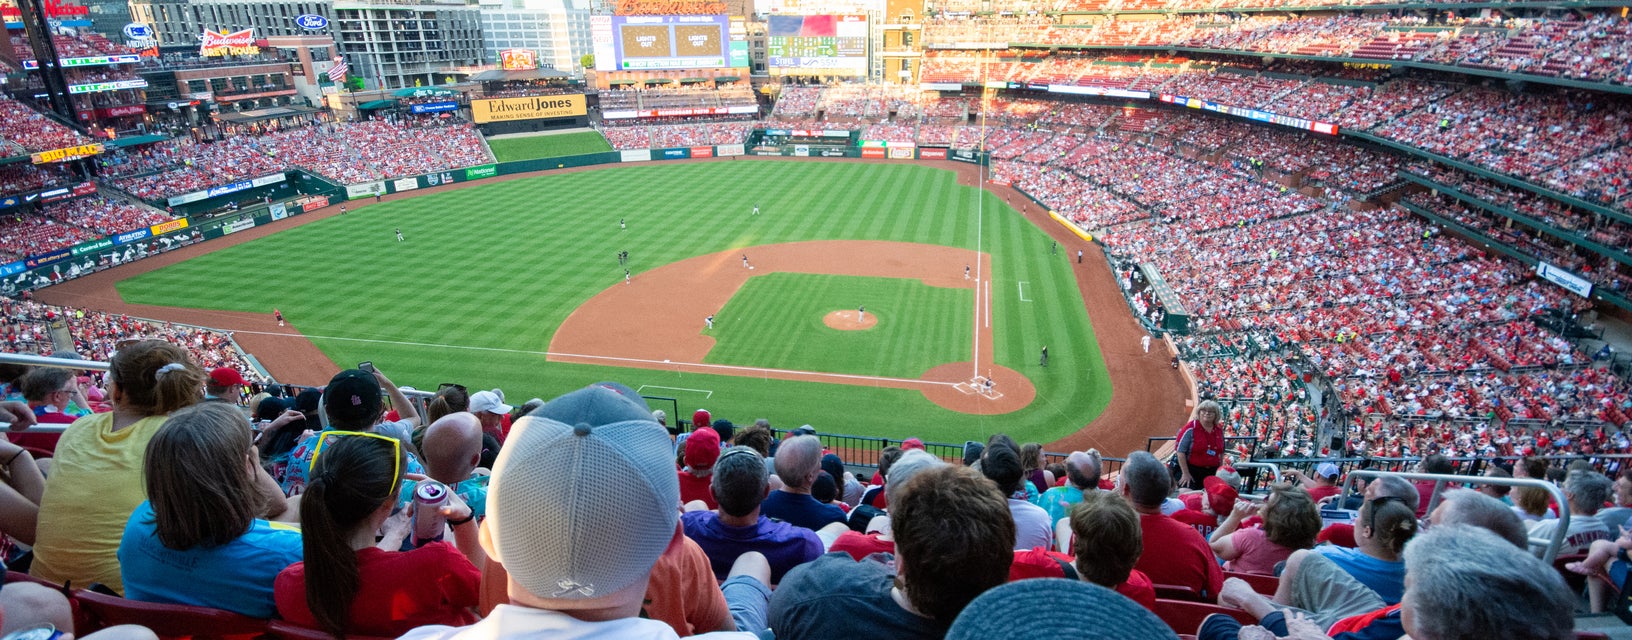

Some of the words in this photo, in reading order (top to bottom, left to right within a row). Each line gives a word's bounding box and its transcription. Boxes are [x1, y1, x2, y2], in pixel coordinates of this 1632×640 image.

[44, 0, 89, 18] Nation
[303, 15, 323, 27] Ford
[125, 39, 158, 49] MIDWEST
[203, 34, 256, 47] Budweiser
[688, 34, 708, 42] LIGHTS
[202, 46, 229, 57] BREW
[230, 45, 260, 56] HOUSE
[488, 99, 535, 113] Edward
[535, 98, 572, 111] Jones
[490, 113, 515, 121] MAKING
[544, 110, 573, 118] INVESTING
[40, 148, 66, 163] BIG
[65, 145, 98, 157] MAC
[473, 167, 496, 176] National
[159, 220, 181, 230] DOBBS
[118, 230, 147, 242] ATHLETICO
[79, 243, 99, 253] Central
[98, 240, 113, 249] Bank
